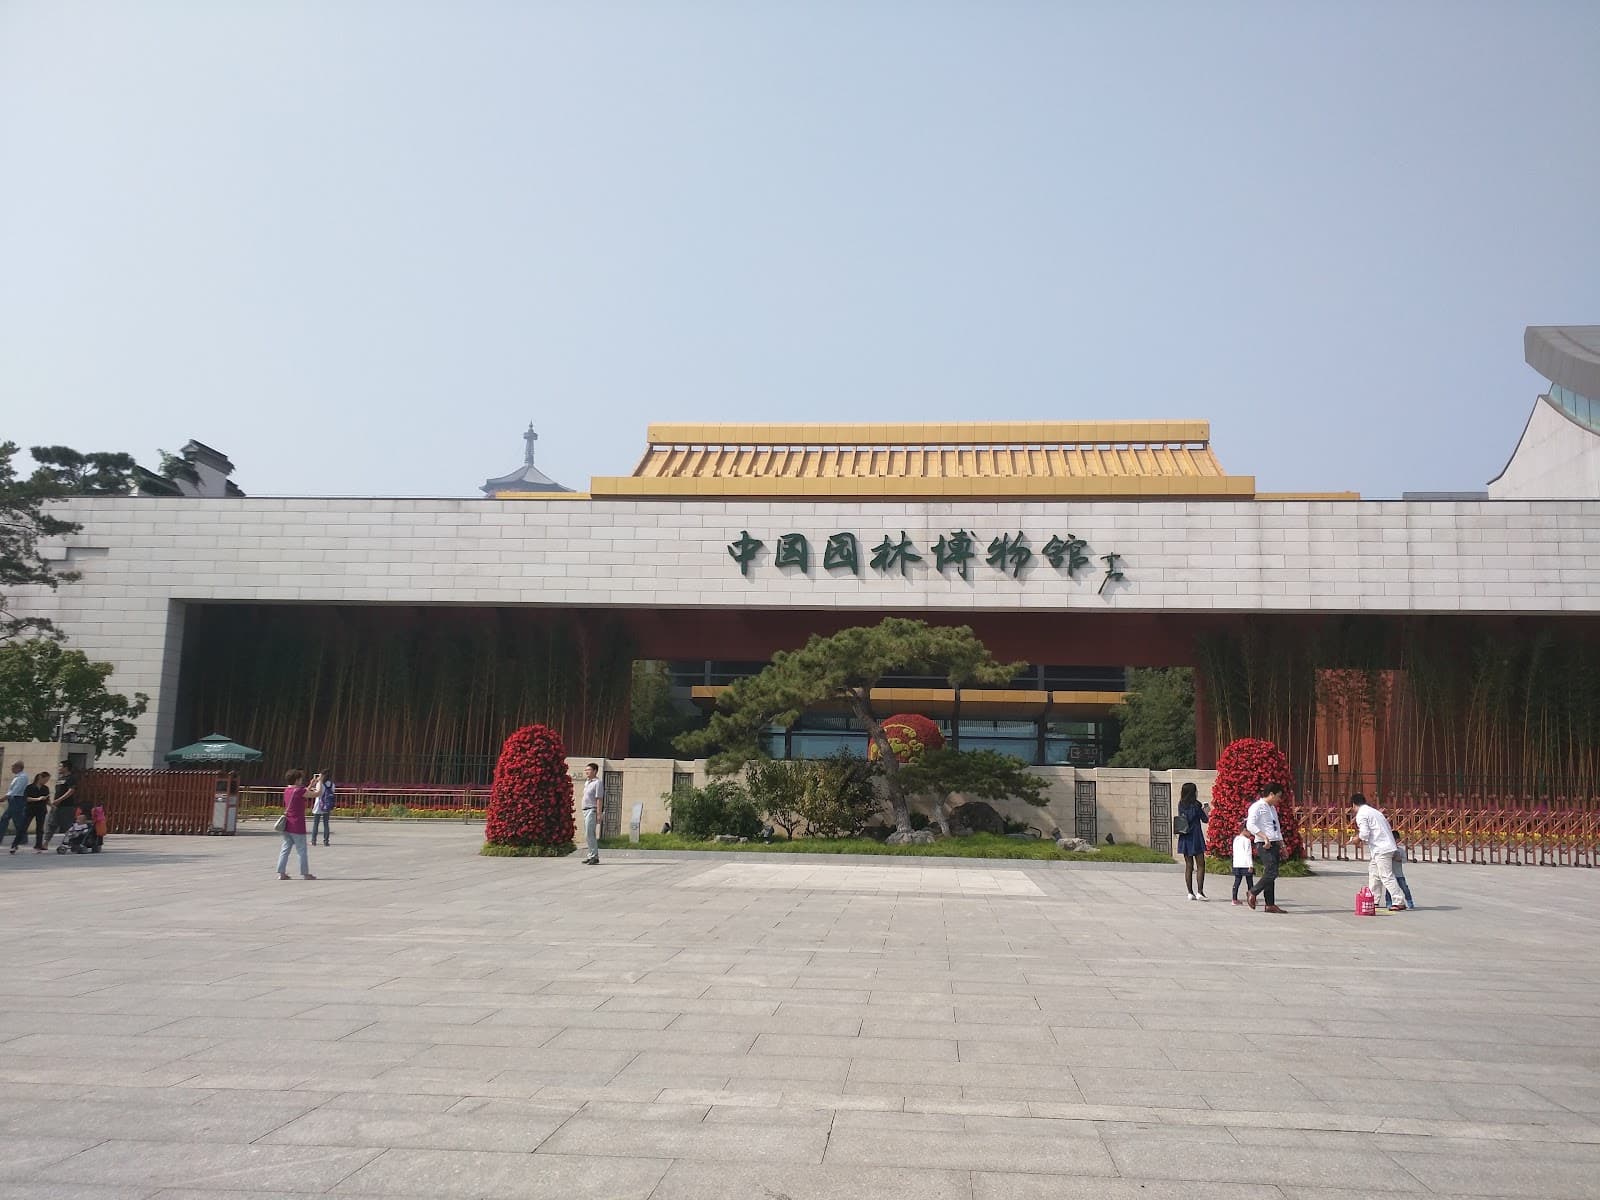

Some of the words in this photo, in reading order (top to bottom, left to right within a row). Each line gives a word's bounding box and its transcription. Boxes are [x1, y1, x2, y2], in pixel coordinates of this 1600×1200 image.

[728, 529, 1089, 580] 中国园林博物馆
